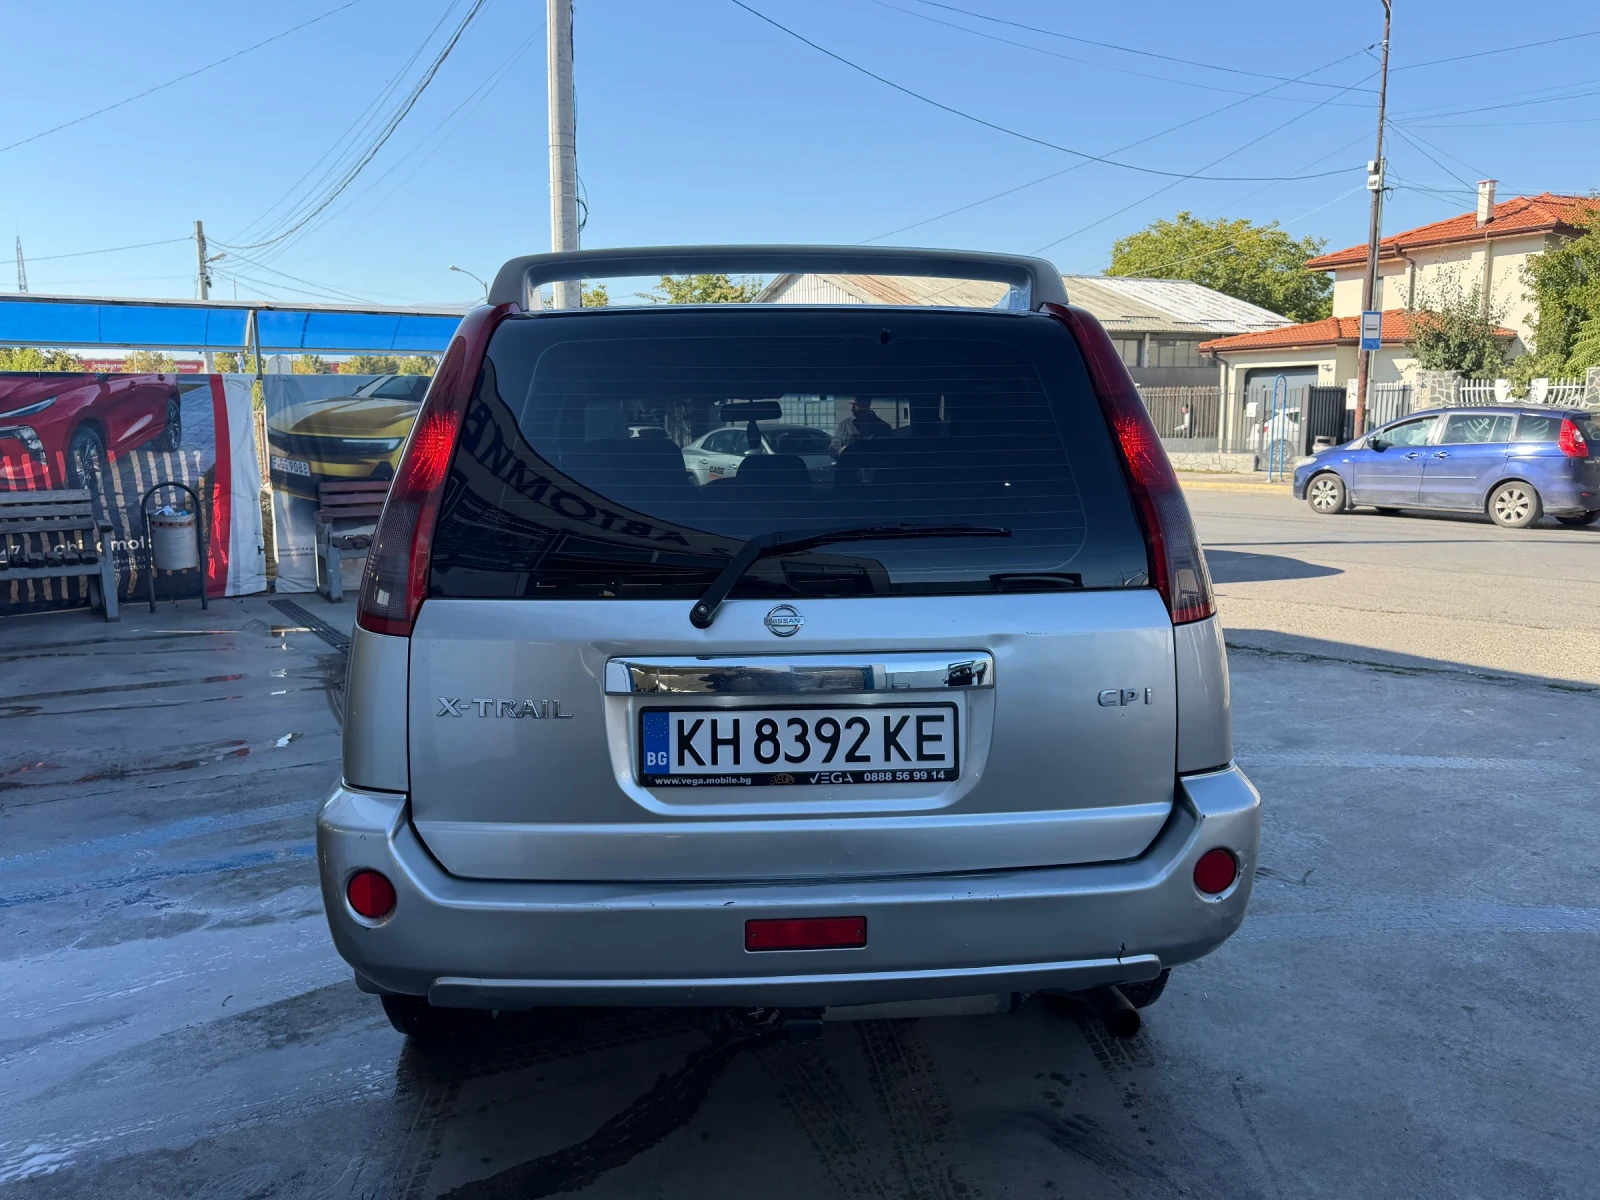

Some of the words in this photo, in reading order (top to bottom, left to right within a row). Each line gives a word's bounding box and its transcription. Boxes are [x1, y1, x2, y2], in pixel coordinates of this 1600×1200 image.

[436, 697, 574, 718] X-TRAIL
[647, 752, 668, 766] BG
[654, 776, 752, 786] www.vega.mobile.bg
[809, 772, 854, 784] VEGA
[863, 772, 893, 782] 0888
[895, 771, 910, 781] 56
[913, 771, 928, 780] 99
[931, 770, 946, 780] 14
